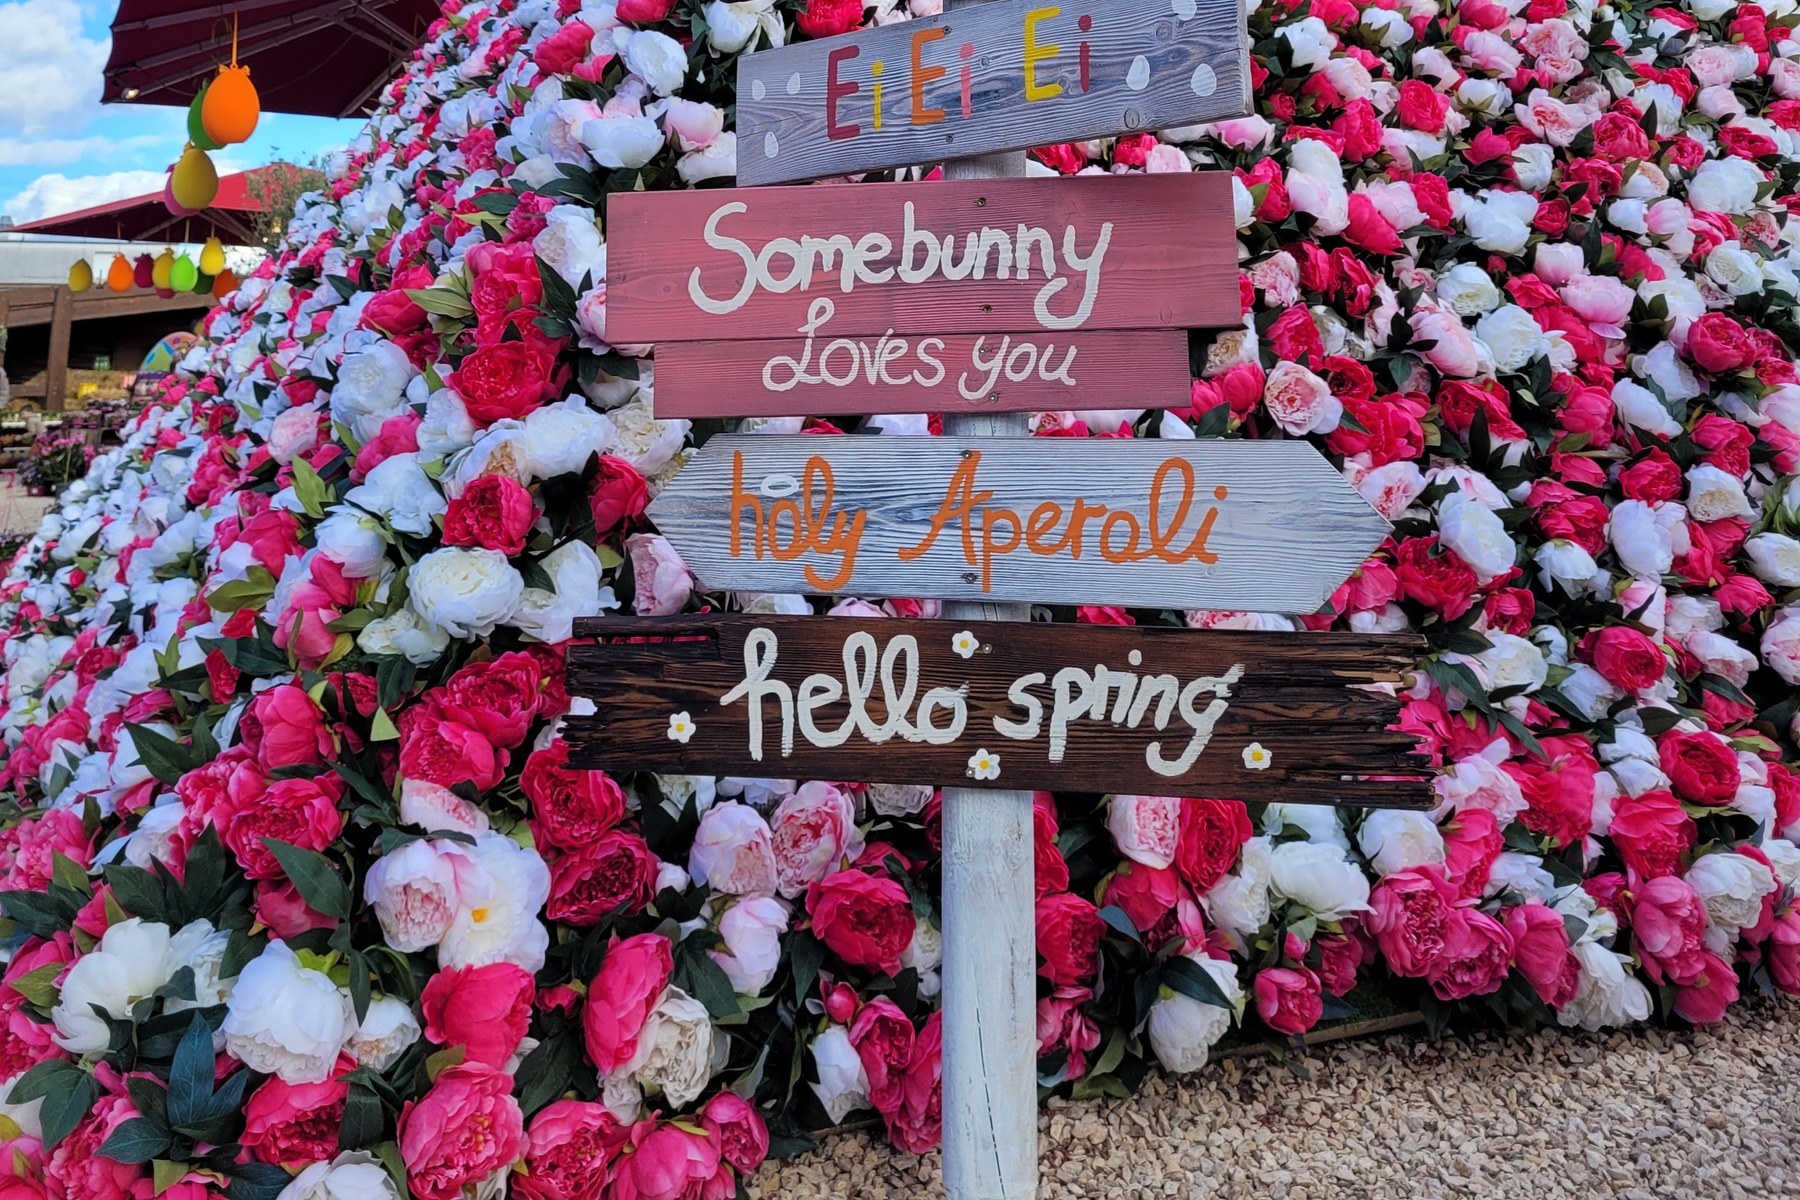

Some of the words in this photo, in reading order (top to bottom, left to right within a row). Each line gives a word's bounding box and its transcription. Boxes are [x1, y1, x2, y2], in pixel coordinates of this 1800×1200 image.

[1024, 6, 1092, 101] Ei
[687, 201, 1113, 330] Somebunny
[957, 335, 1077, 400] you
[730, 450, 866, 591] holy
[898, 450, 1228, 593] Aperoli
[720, 627, 970, 762] hello
[993, 649, 1245, 777] spring
